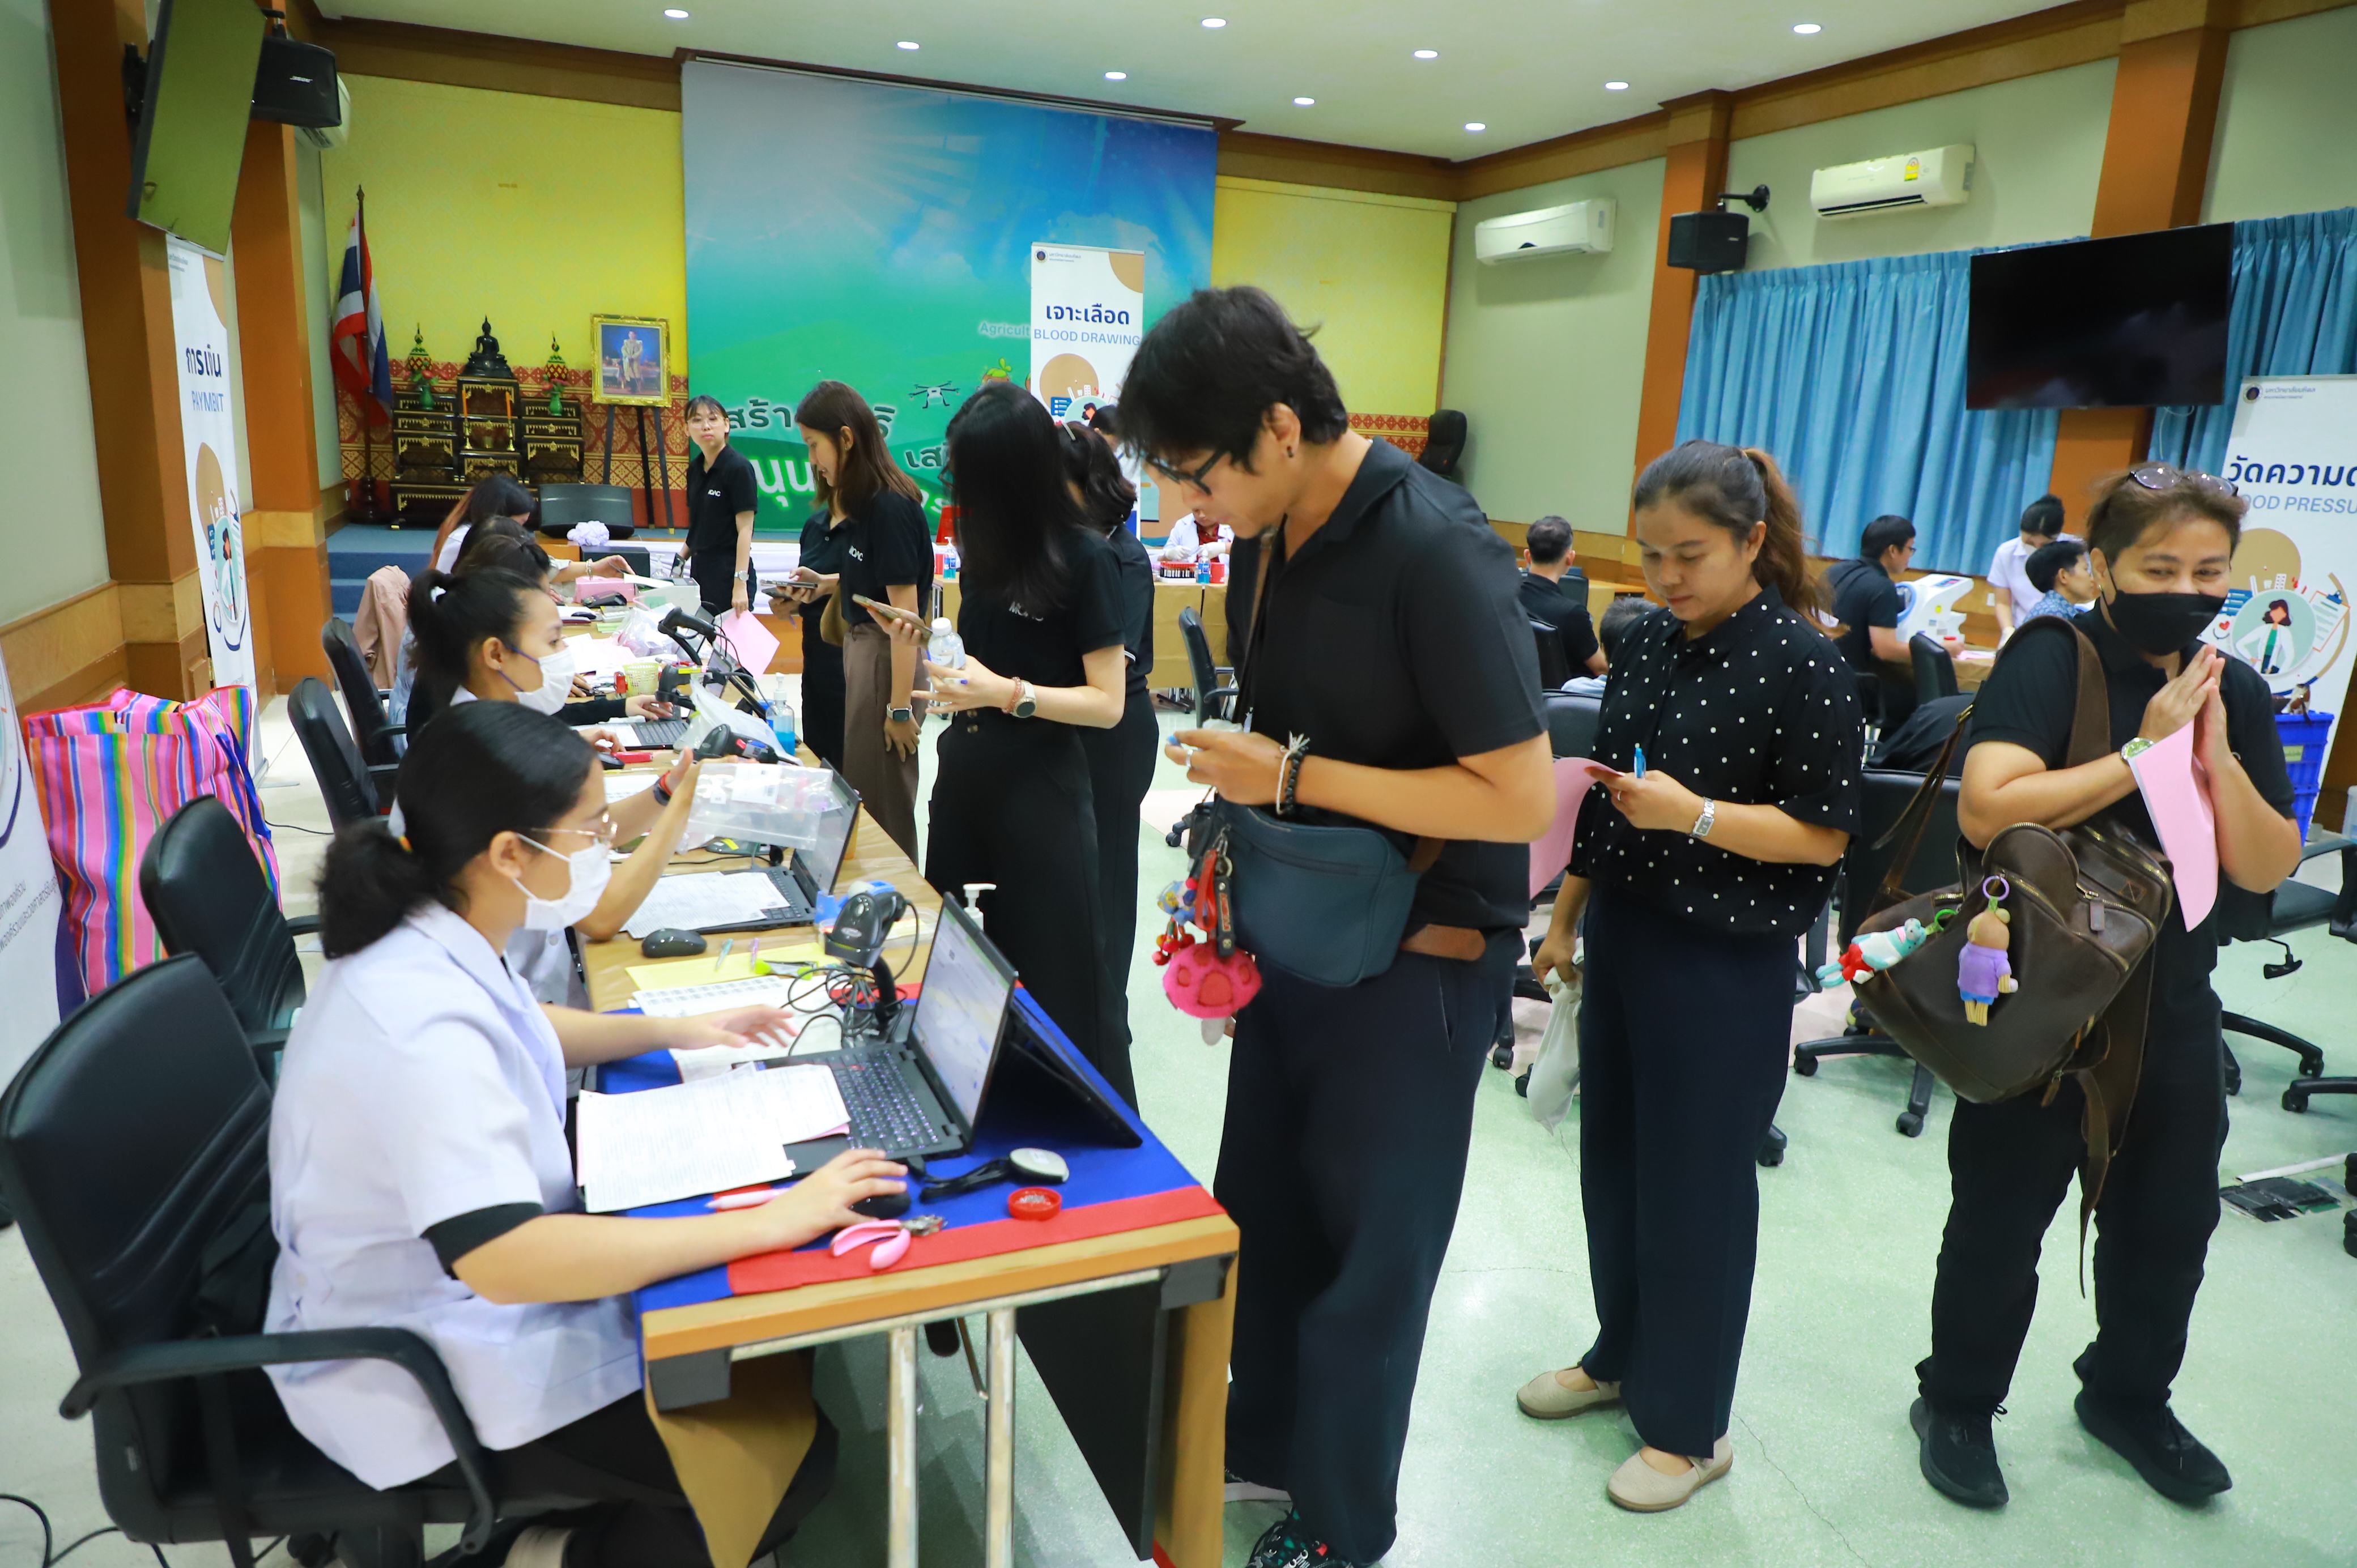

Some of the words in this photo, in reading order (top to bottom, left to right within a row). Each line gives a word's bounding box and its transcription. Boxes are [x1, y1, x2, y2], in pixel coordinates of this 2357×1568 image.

[1046, 303, 1130, 325] เจาะเลือด
[1034, 329, 1077, 341] BLOOD
[1081, 332, 1141, 346] DRAWING
[186, 343, 222, 378] การเงิน
[192, 390, 224, 412] PAYMENT
